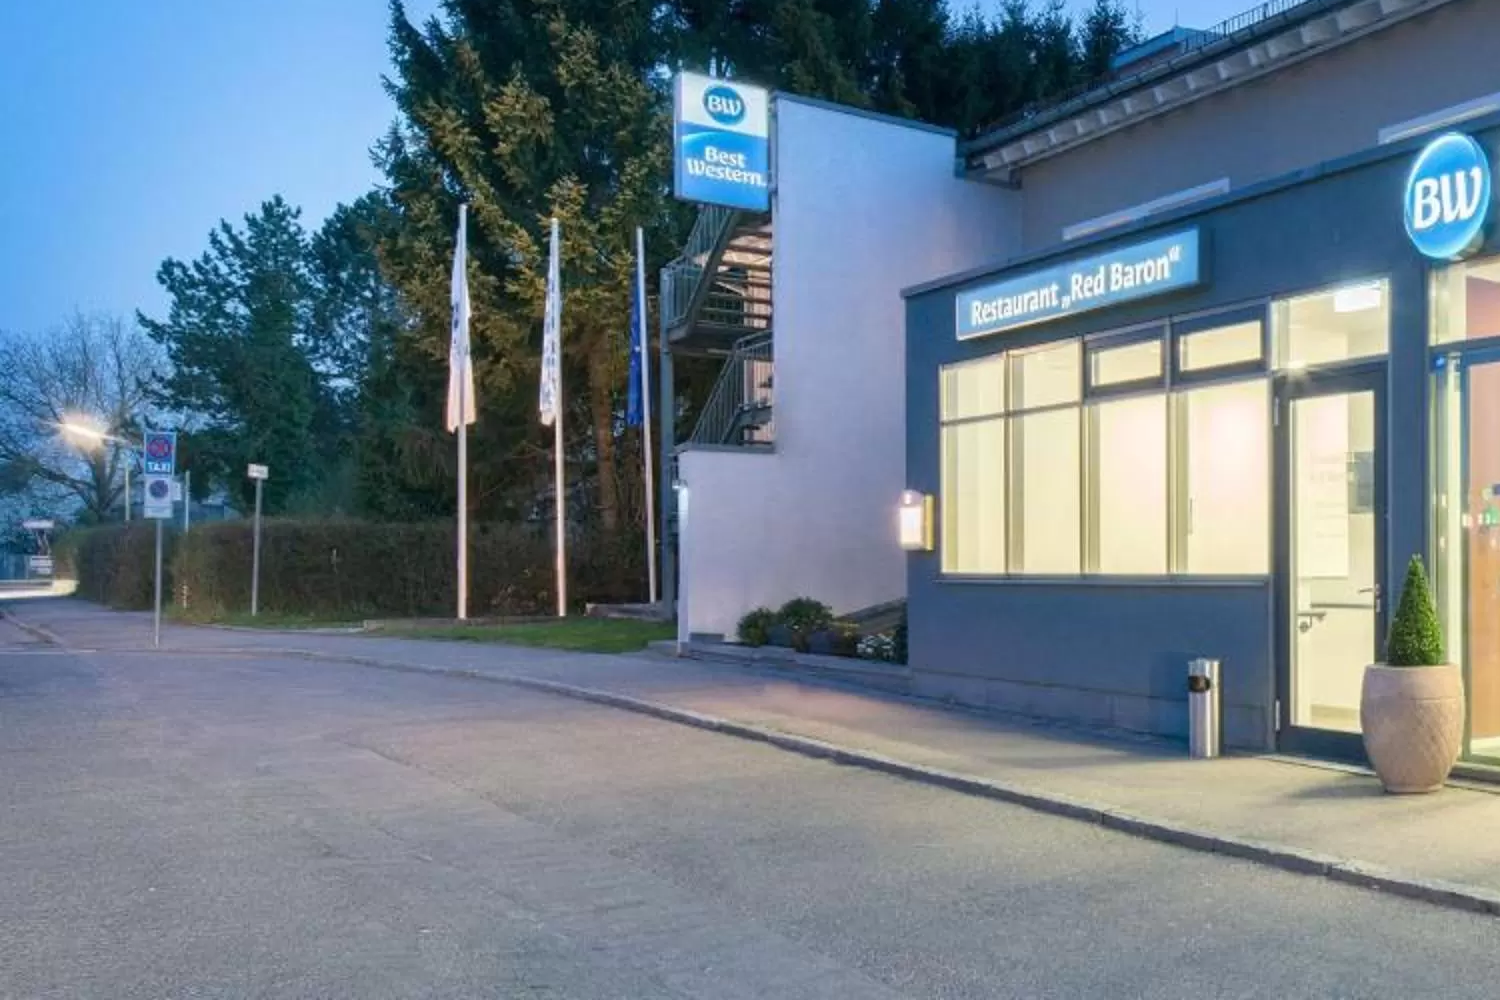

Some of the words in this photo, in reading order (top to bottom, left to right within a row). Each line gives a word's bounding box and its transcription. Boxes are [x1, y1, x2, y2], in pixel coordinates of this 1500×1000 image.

[707, 94, 741, 116] BW
[704, 145, 746, 169] Best
[1411, 166, 1484, 230] BW
[970, 281, 1059, 327] Restaurant
[146, 461, 171, 473] TAXI
